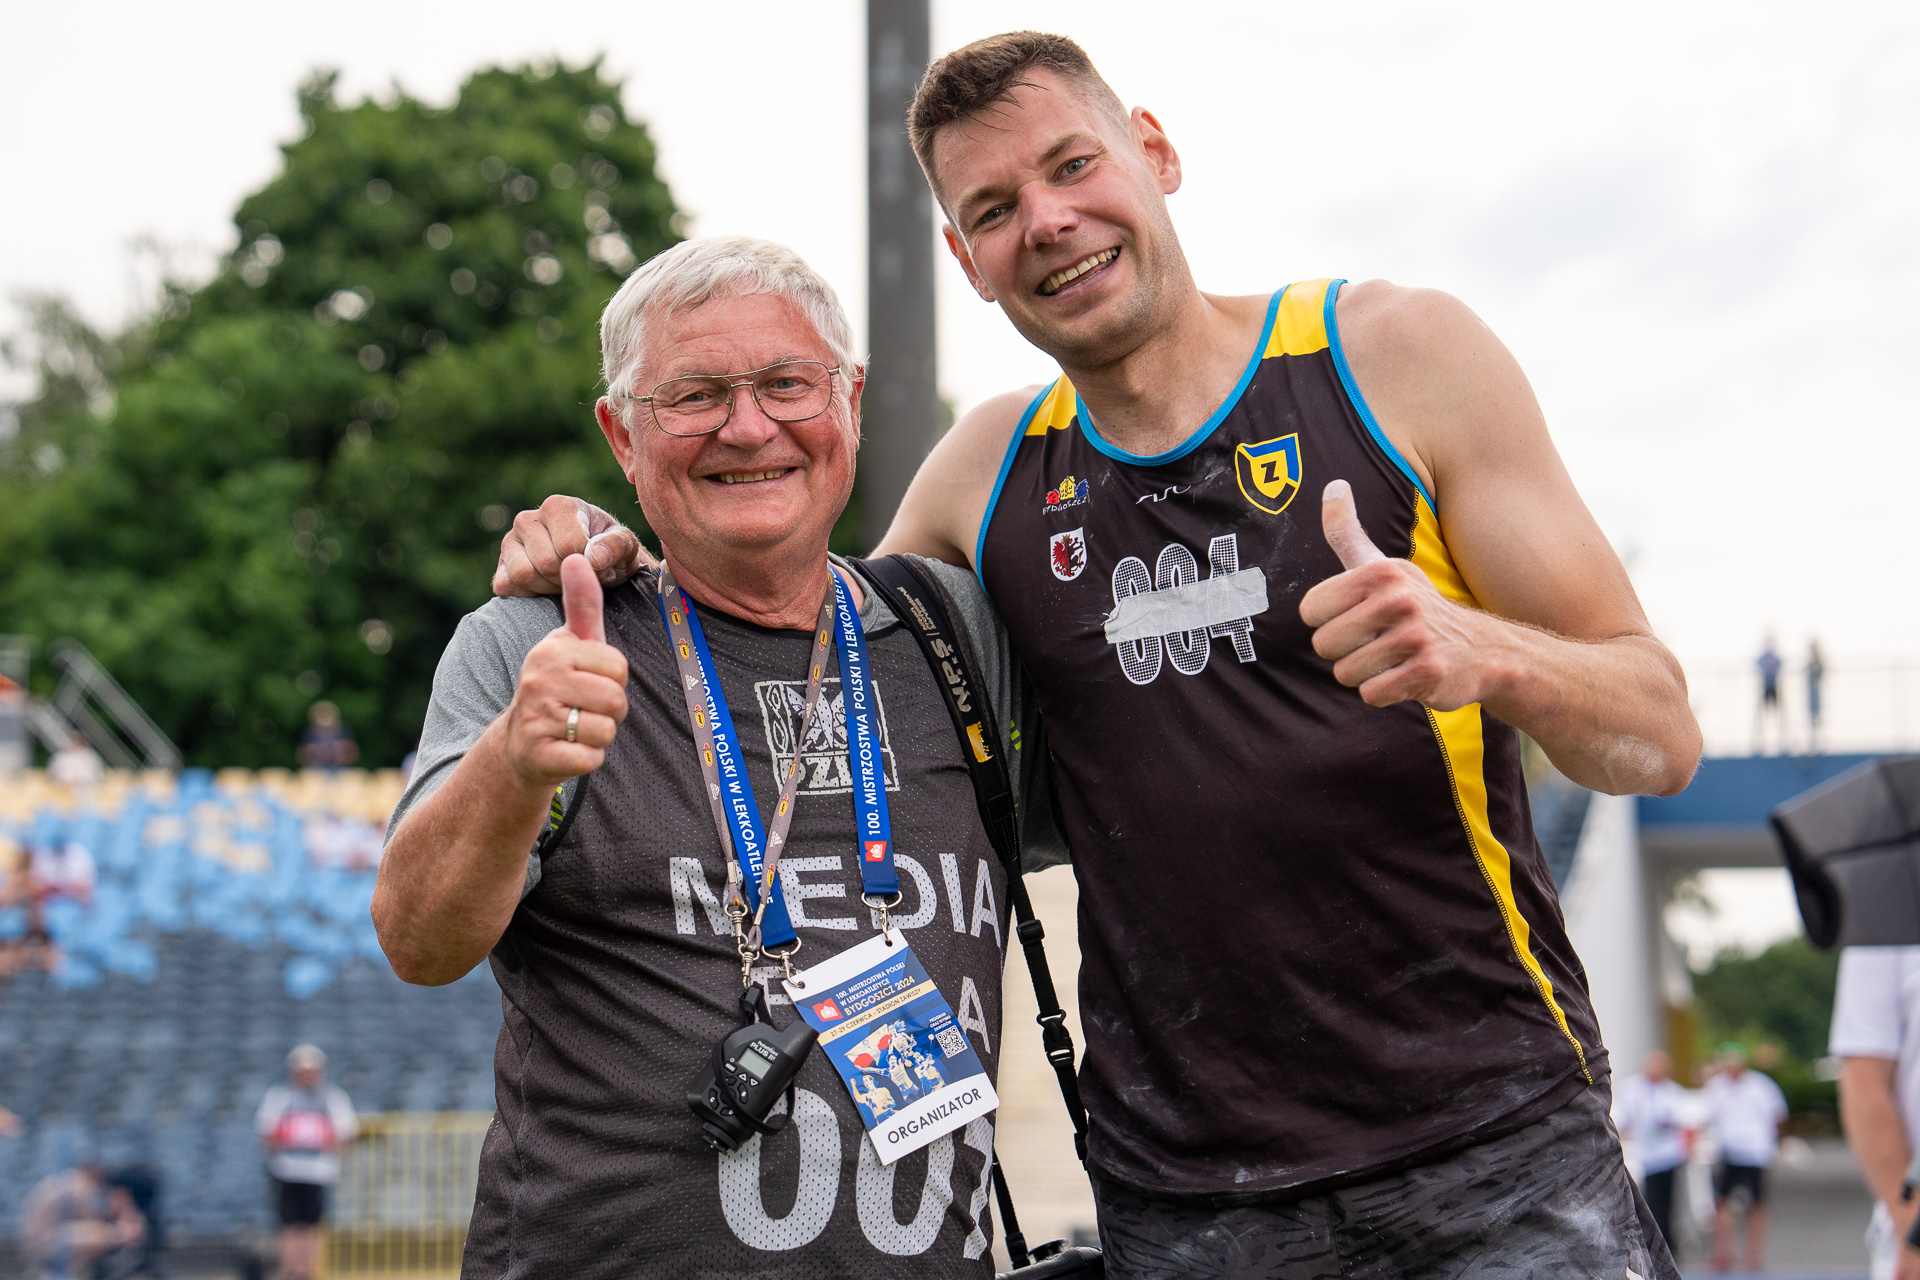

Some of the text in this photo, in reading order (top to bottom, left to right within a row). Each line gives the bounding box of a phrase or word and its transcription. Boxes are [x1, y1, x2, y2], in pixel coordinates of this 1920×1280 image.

[1260, 460, 1280, 484] Z
[848, 650, 860, 663] W
[931, 638, 972, 713] NPS
[850, 665, 867, 710] POLSKI
[713, 733, 738, 778] POLSKI
[728, 781, 742, 794] W
[856, 713, 878, 806] MISTRZOSTWA
[867, 809, 881, 836] 100.
[669, 852, 1002, 949] MEDIA
[843, 975, 916, 1016] BYDGOSZCZ 2024
[846, 978, 891, 1004] LEKKOATLETYCE
[848, 971, 887, 994] MISTRZOSTWA
[885, 961, 906, 975] POLSKI
[829, 1026, 846, 1038] 27-29
[846, 1012, 873, 1029] CZERWCA
[875, 999, 900, 1014] STADION
[899, 988, 922, 1004] ZAWISZY
[750, 1042, 769, 1059] PLUS
[887, 1088, 982, 1144] ORGANIZATOR
